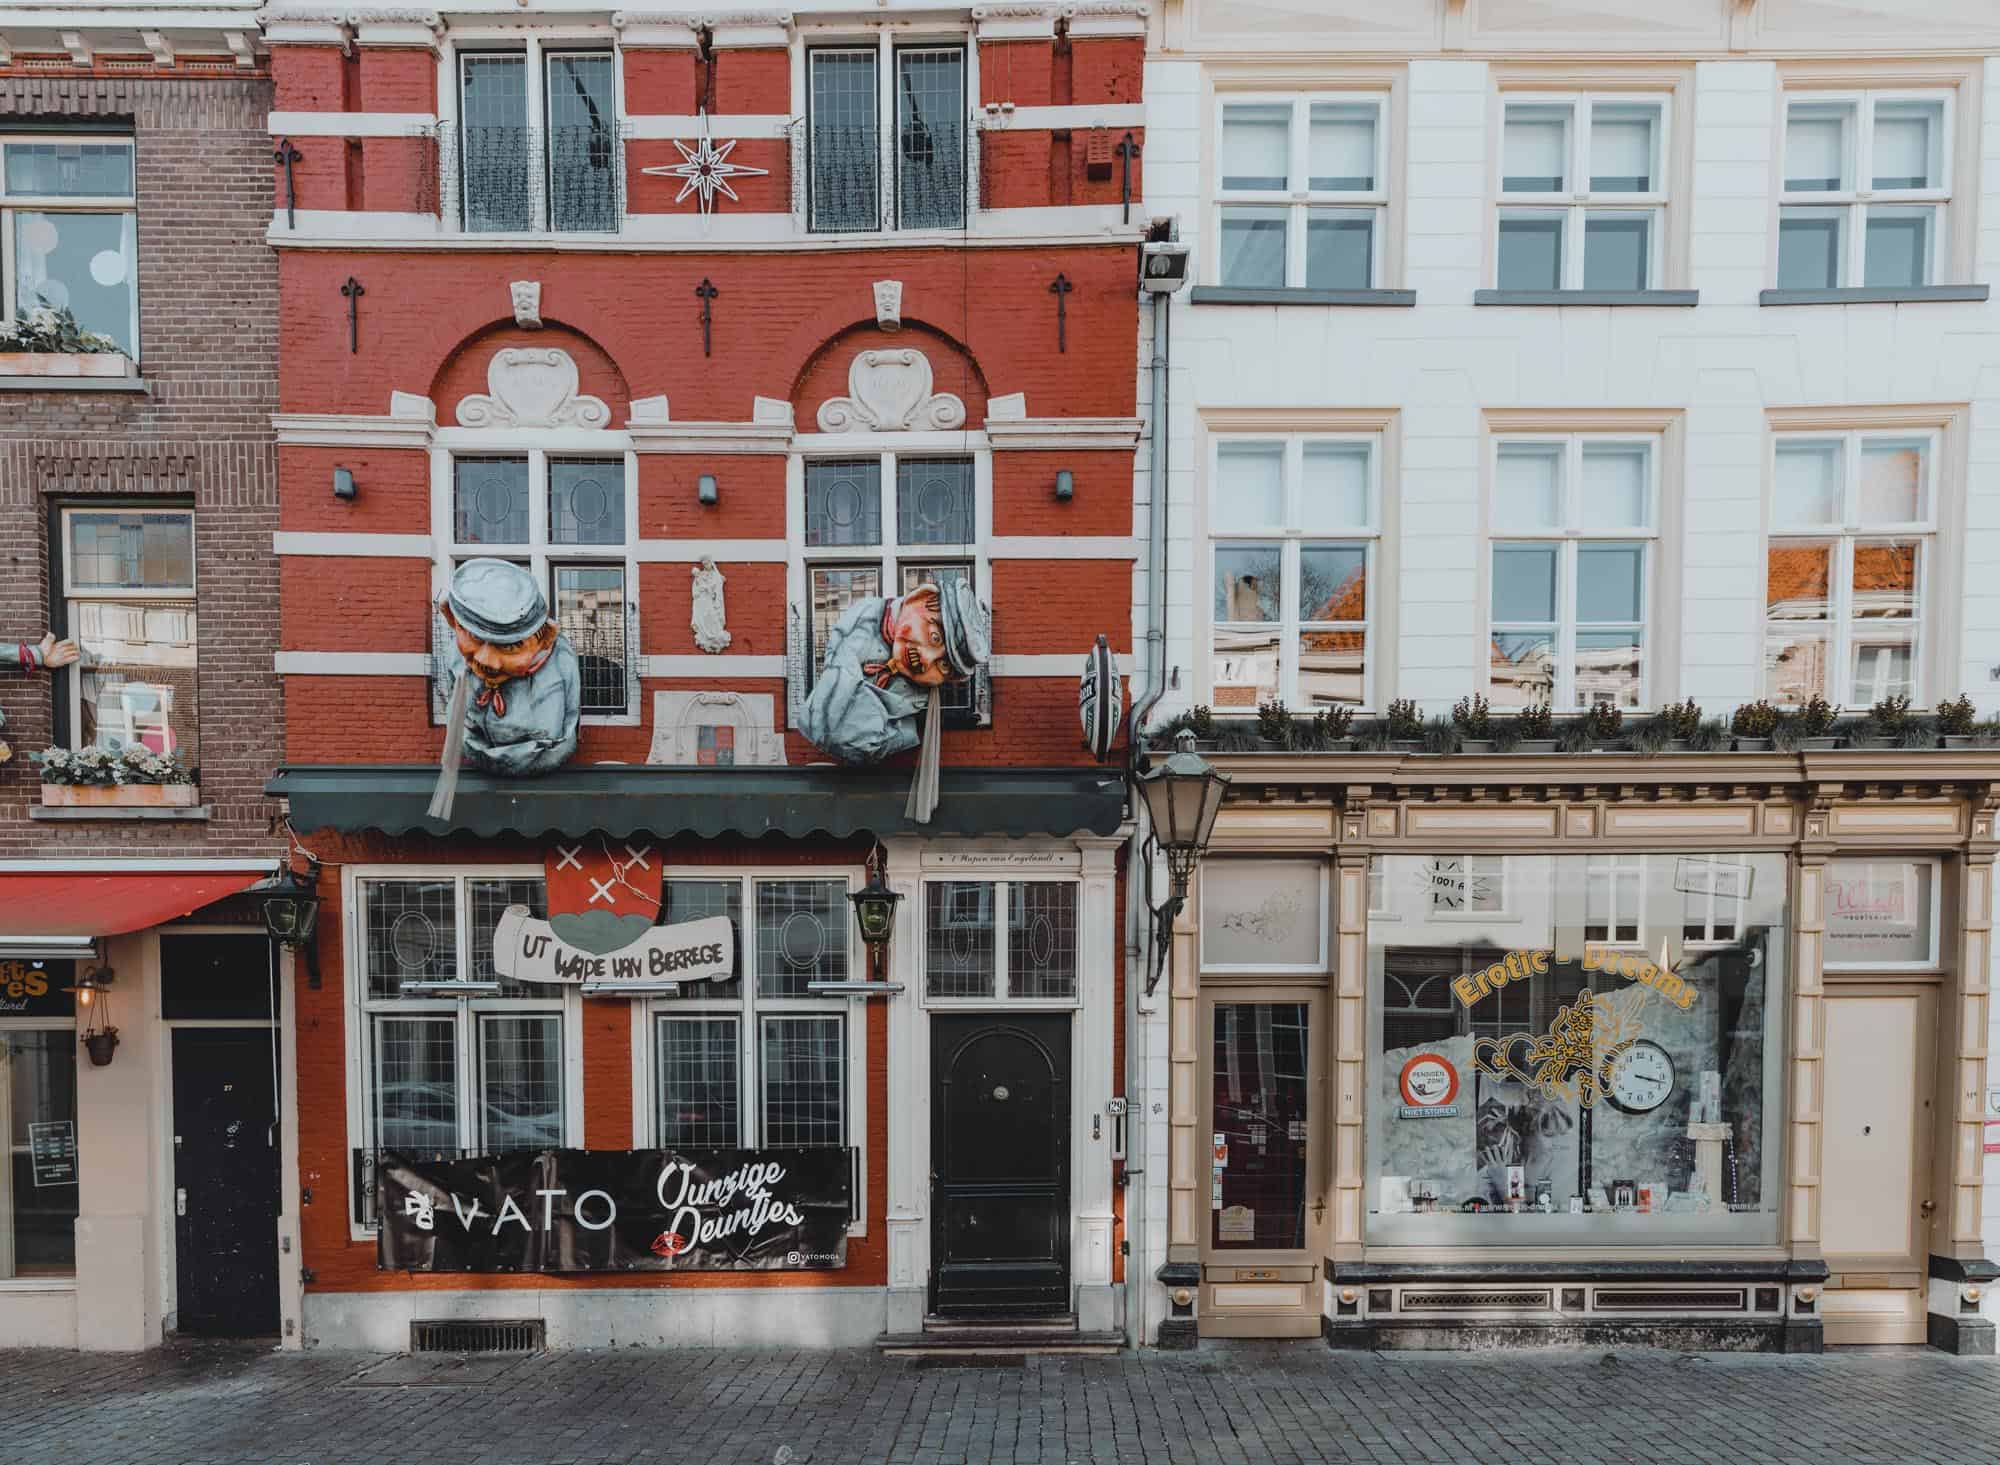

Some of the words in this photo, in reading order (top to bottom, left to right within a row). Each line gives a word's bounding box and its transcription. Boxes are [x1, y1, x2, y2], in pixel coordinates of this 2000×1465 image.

[523, 934, 552, 959] UT
[1453, 950, 1549, 1008] Erotic
[1584, 944, 1698, 1010] Dreams
[454, 1188, 617, 1236] VATO
